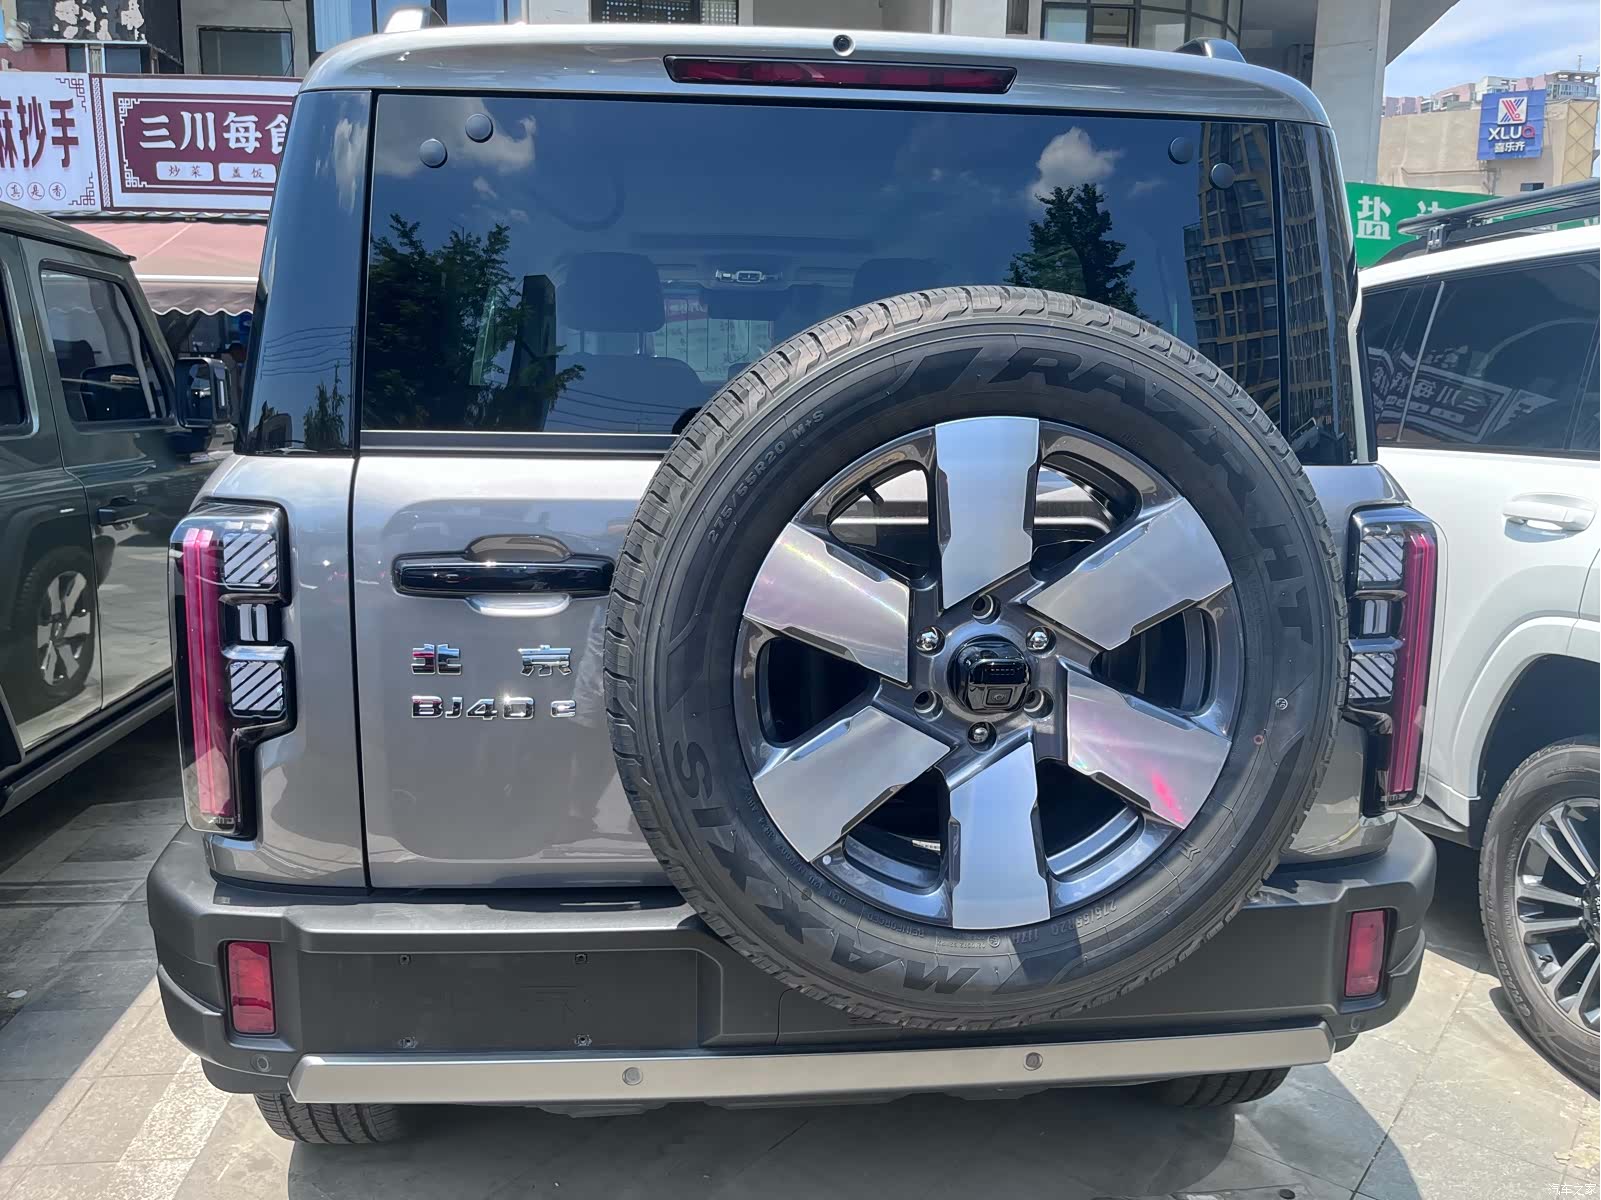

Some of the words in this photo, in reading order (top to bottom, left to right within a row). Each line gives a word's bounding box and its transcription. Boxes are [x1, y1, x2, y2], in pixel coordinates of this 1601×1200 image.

[168, 165, 202, 178] 炒菜
[231, 166, 263, 179] 盖饭
[706, 442, 787, 544] 275/55R20
[790, 409, 825, 438] M+S
[411, 695, 534, 720] BJ40
[673, 741, 981, 994] MAXXIS
[866, 911, 925, 937] REINFORCED
